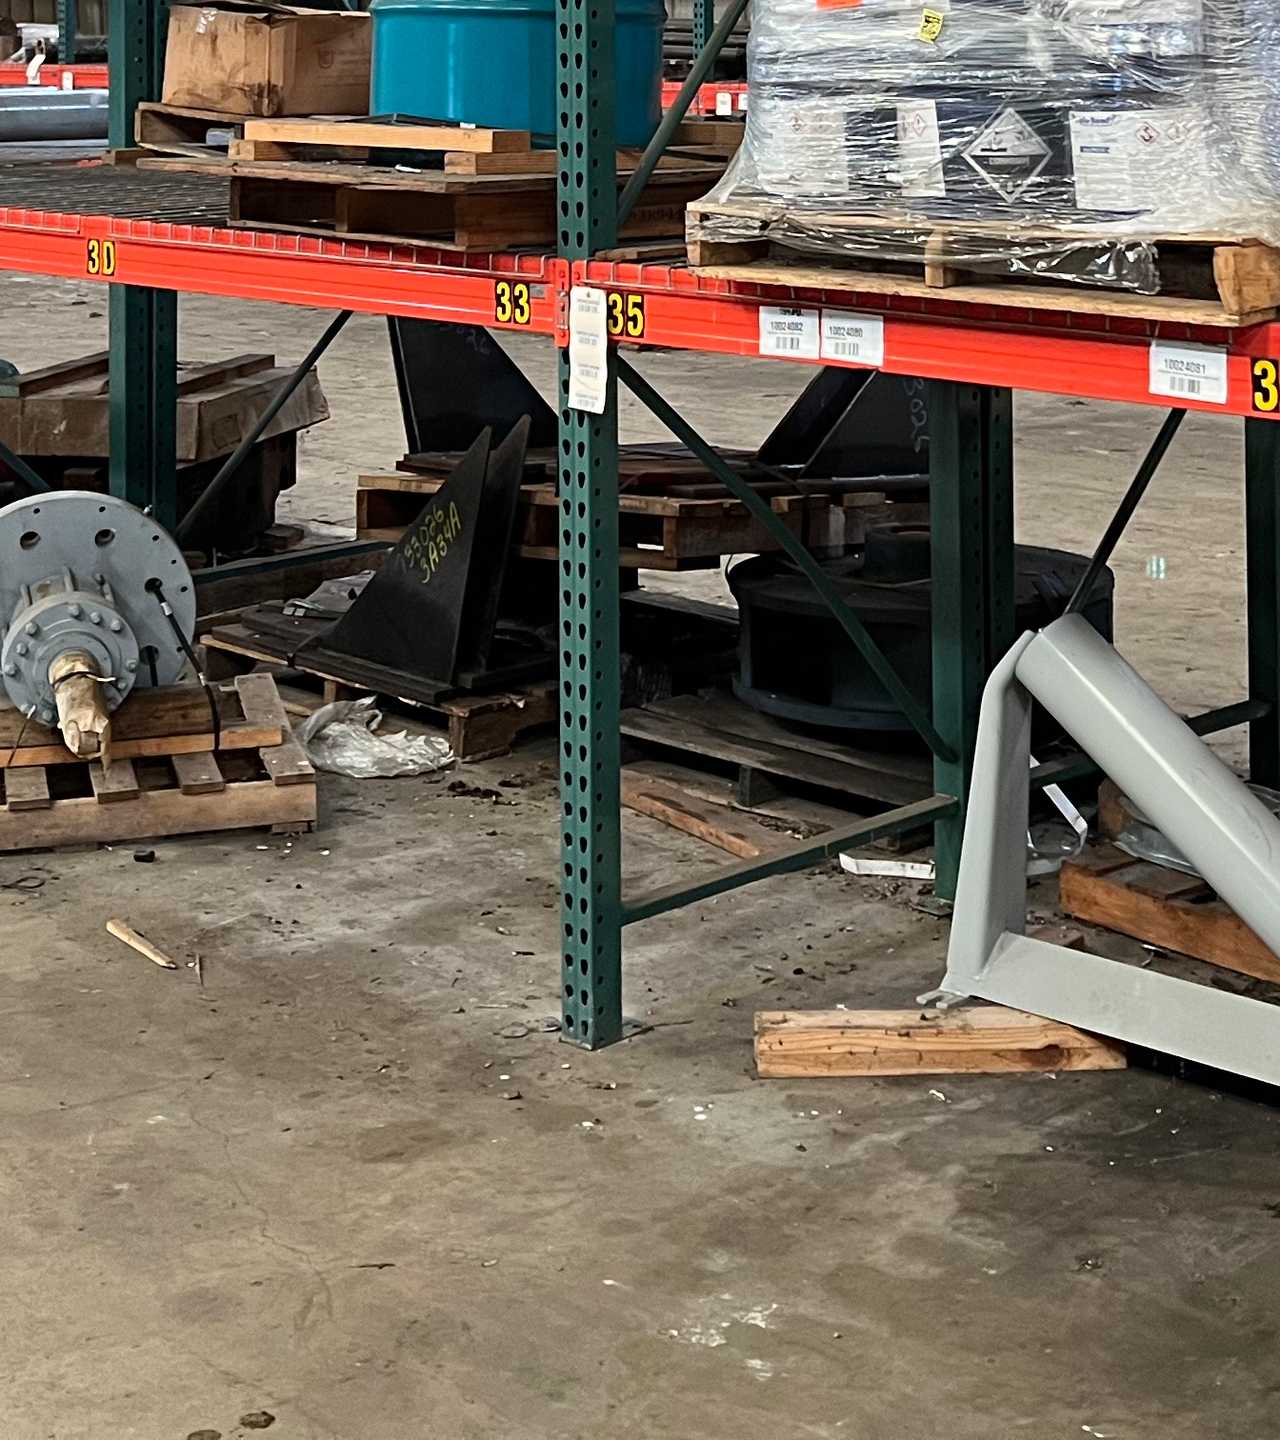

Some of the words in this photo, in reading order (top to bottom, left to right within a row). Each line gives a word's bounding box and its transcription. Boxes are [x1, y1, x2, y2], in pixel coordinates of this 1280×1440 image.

[88, 239, 115, 275] 3D
[496, 282, 530, 324] 33
[608, 293, 644, 336] 35
